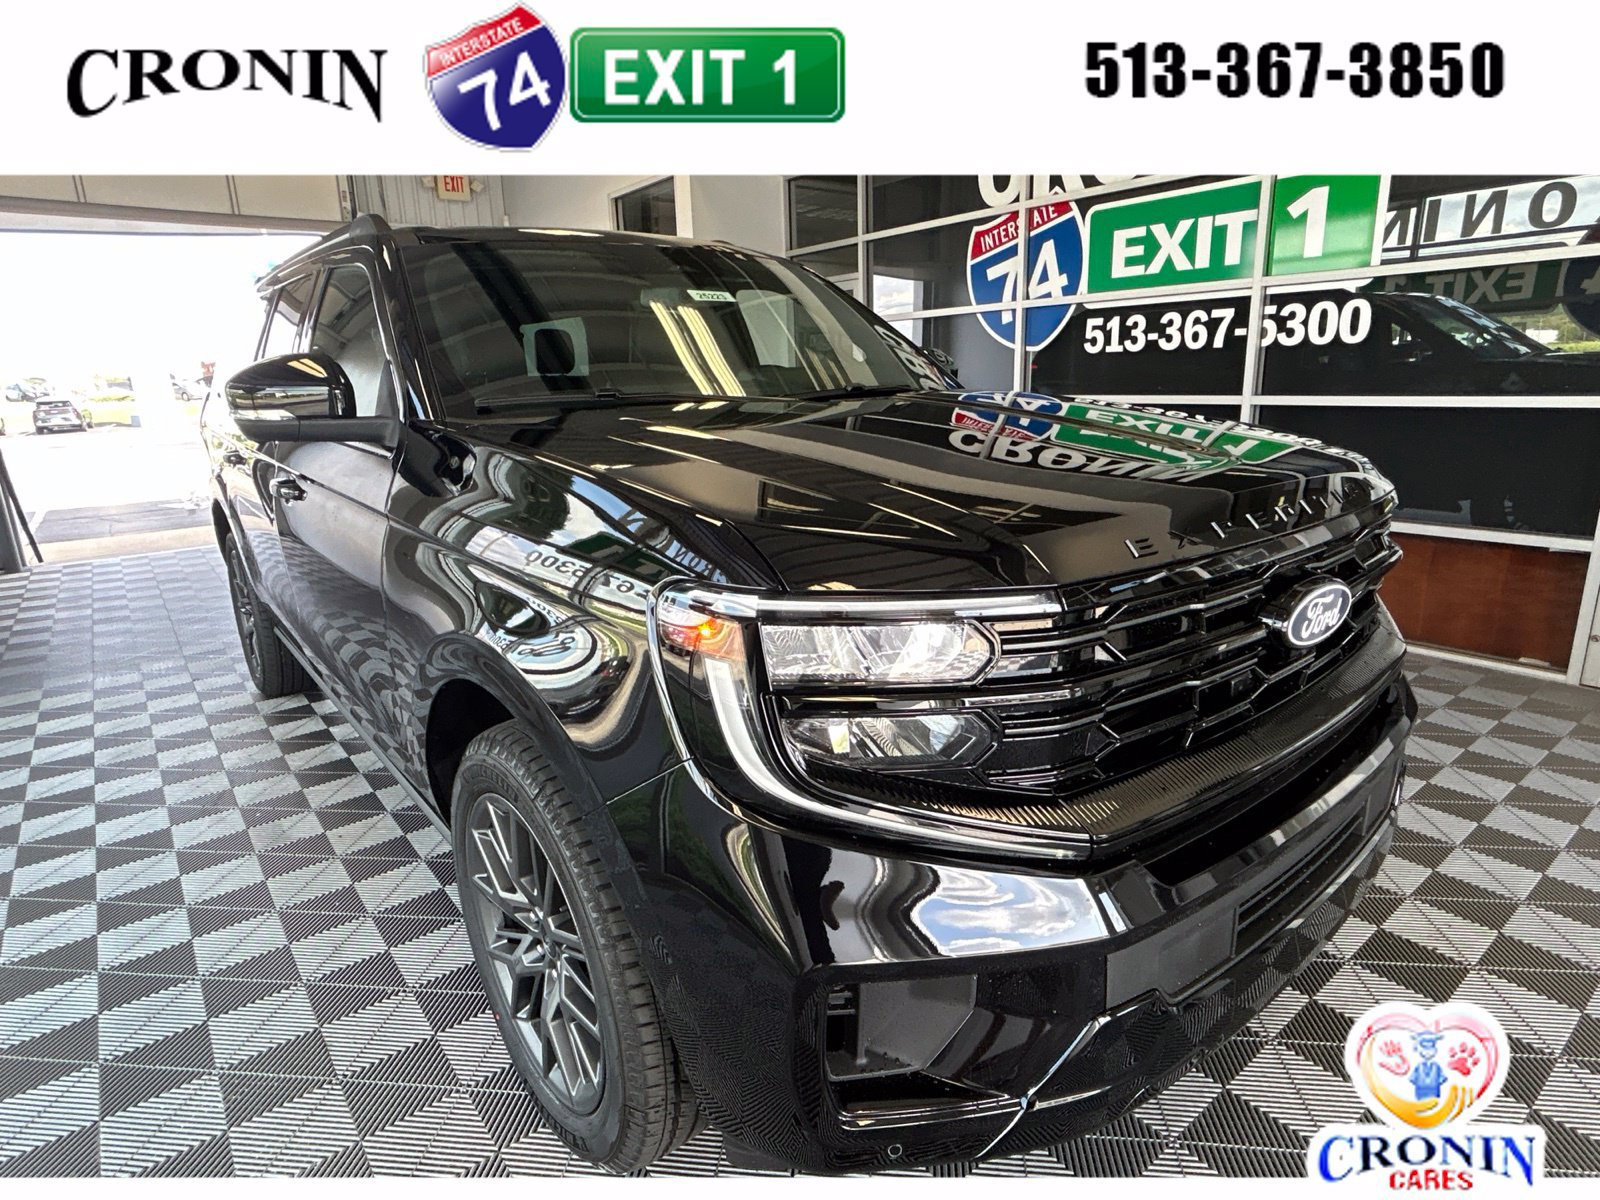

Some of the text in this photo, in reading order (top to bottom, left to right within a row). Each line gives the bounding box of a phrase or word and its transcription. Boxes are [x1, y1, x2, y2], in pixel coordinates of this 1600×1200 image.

[443, 175, 465, 193] EXIT
[981, 206, 1058, 253] INTERATE
[1111, 185, 1330, 279] EXIT 1
[986, 238, 1069, 325] 74
[1083, 298, 1373, 355] 513-367-5300
[1301, 593, 1343, 639] Ford
